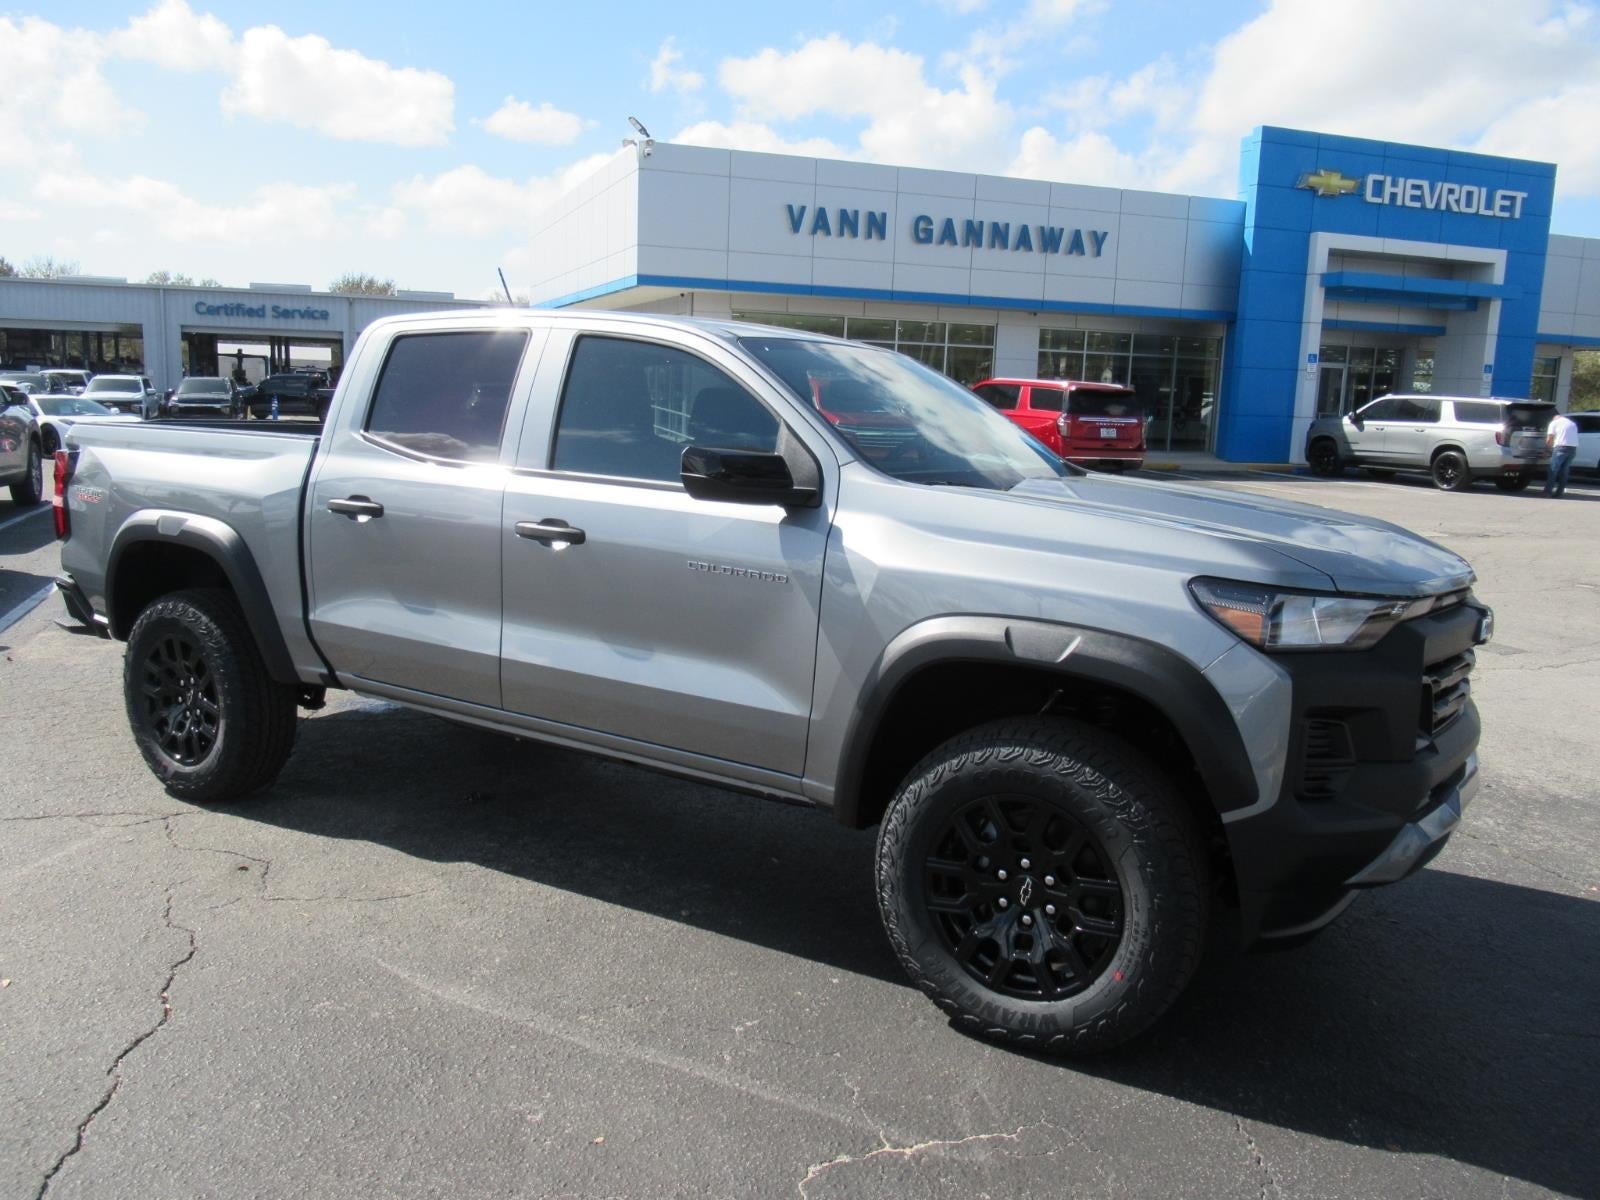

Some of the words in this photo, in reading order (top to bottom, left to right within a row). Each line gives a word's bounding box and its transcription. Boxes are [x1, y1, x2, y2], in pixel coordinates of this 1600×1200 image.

[1365, 173, 1528, 219] CHEVROLET
[786, 203, 887, 241] VANN
[912, 214, 1109, 258] GANNAWAY
[194, 301, 266, 319] Certified
[271, 304, 329, 321] Service
[687, 560, 789, 584] COLORADO
